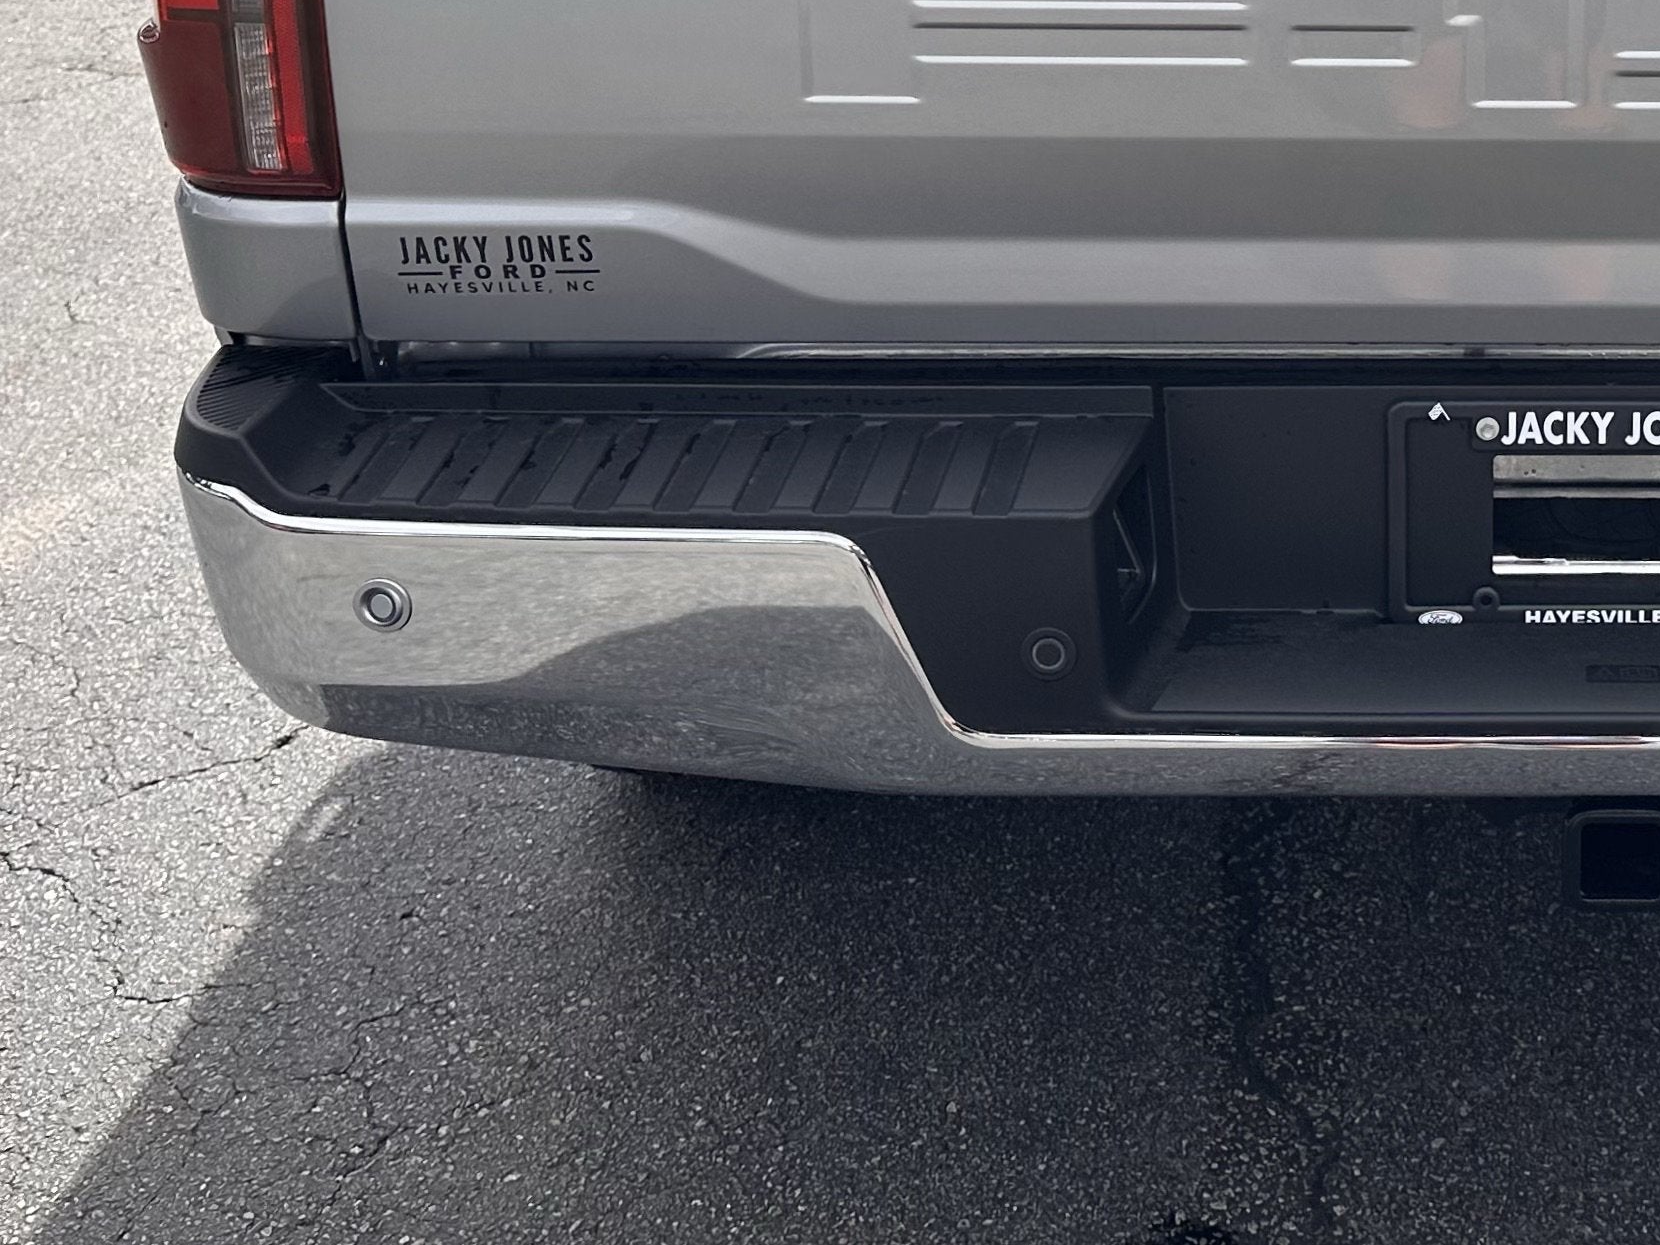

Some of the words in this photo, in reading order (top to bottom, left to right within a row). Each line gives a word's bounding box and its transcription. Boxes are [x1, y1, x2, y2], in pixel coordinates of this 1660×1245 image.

[399, 236, 487, 264] JACKY
[505, 235, 593, 263] JONES
[449, 264, 546, 280] FORD
[407, 281, 552, 294] HAYESVILLE,
[567, 280, 595, 292] NC
[1501, 411, 1615, 445] JACKY
